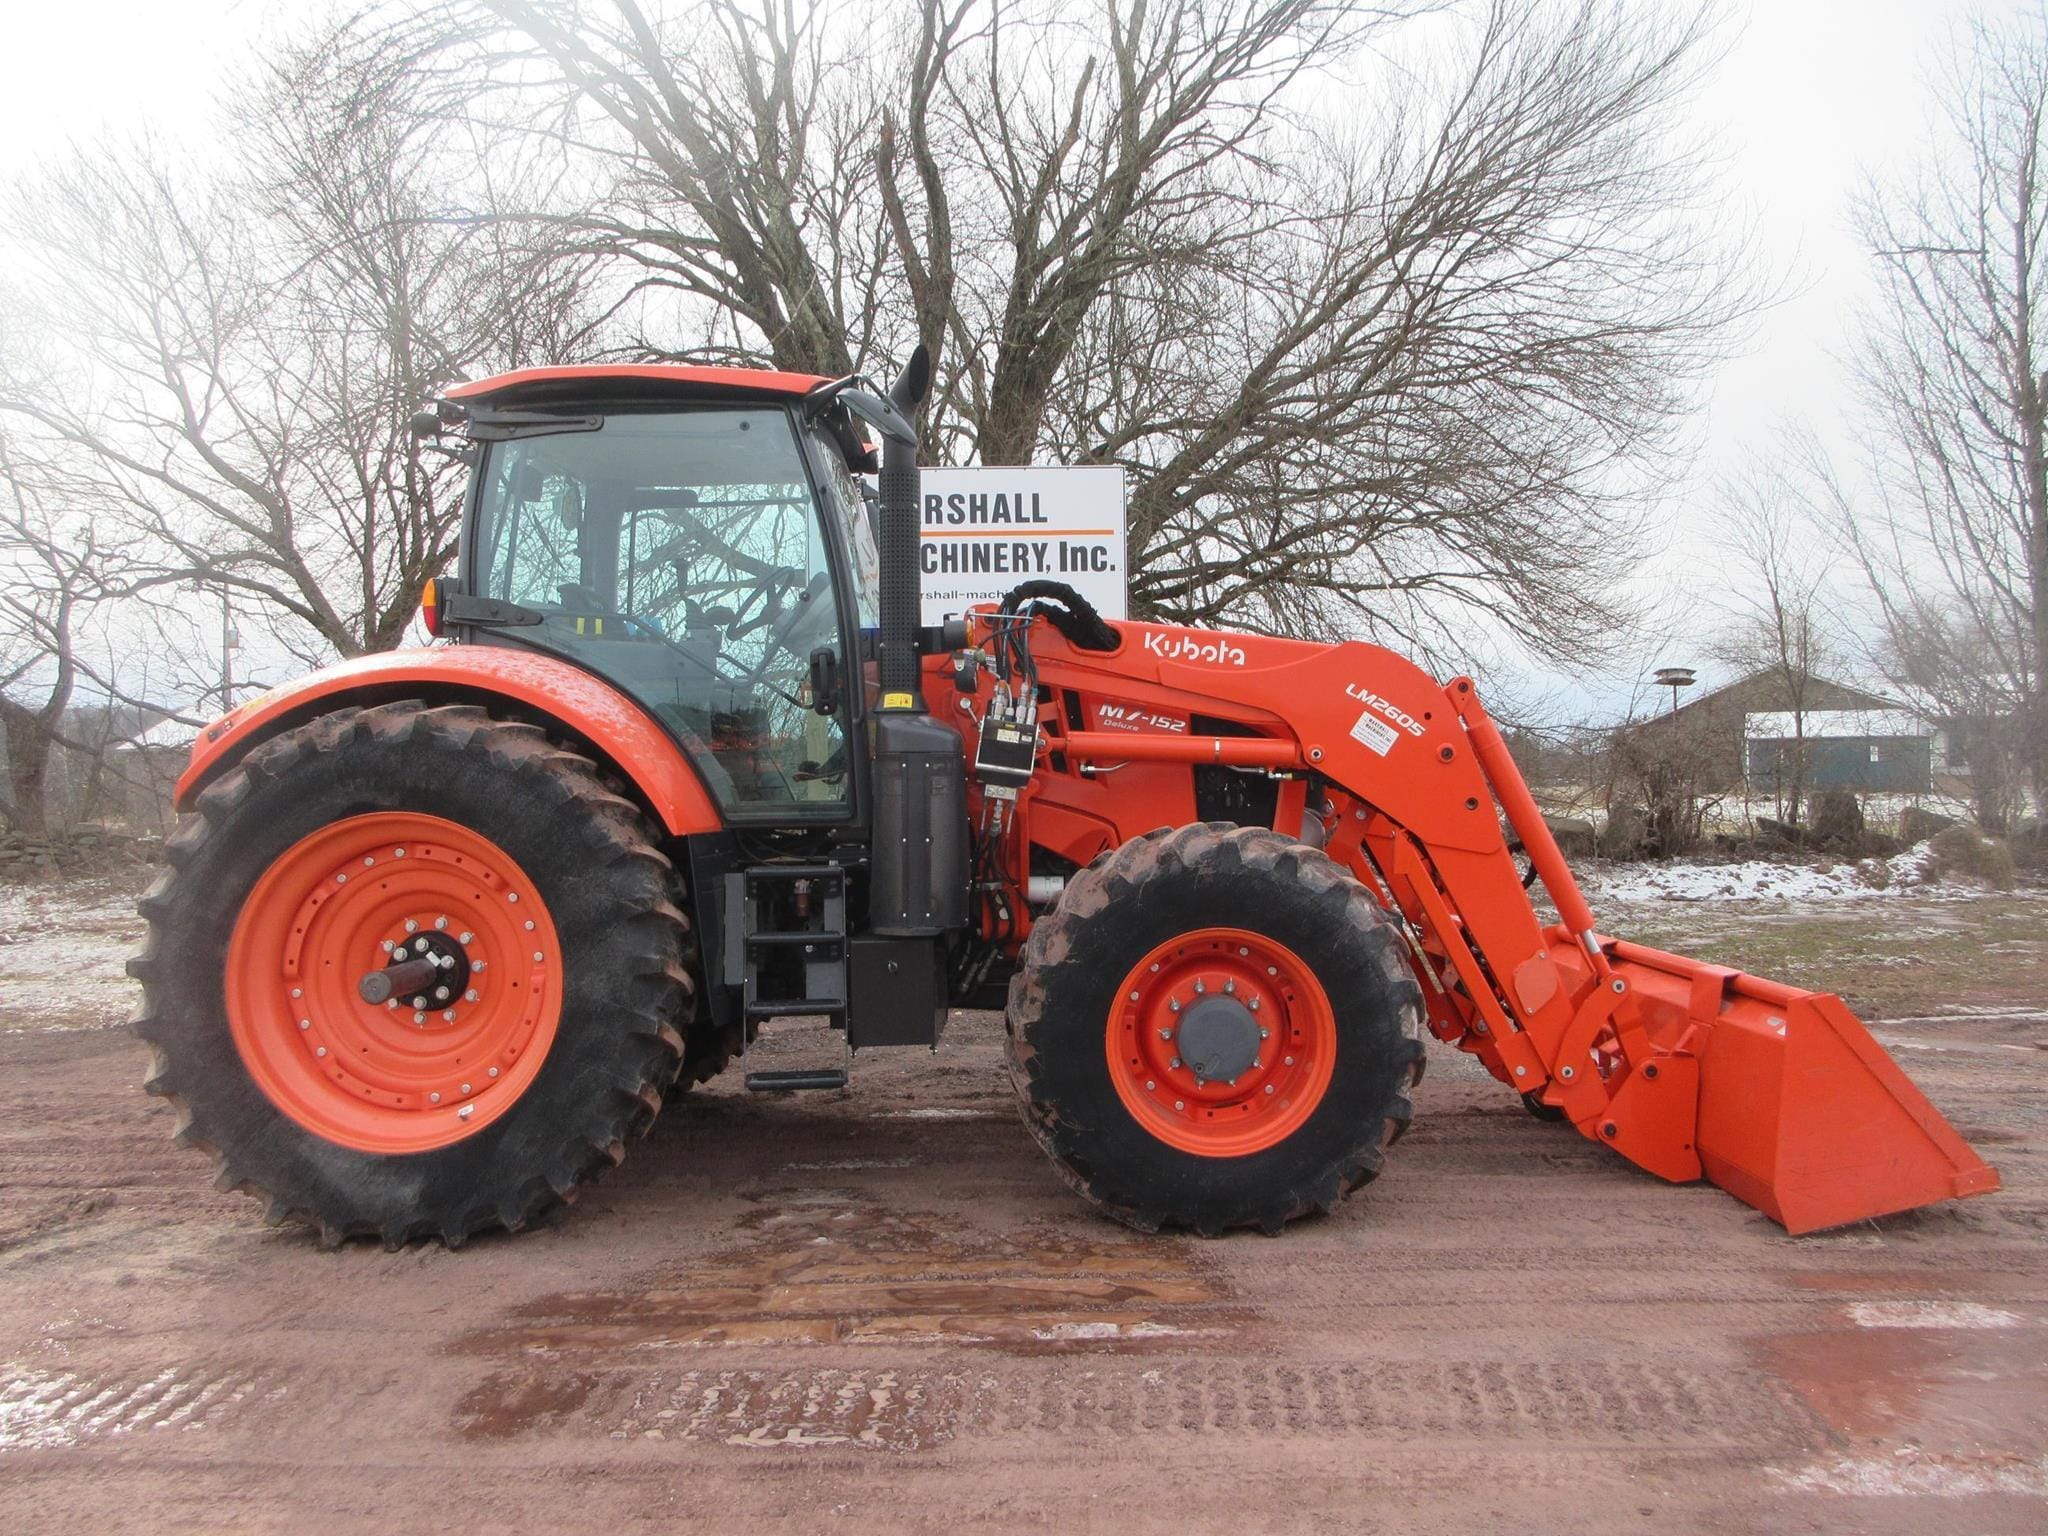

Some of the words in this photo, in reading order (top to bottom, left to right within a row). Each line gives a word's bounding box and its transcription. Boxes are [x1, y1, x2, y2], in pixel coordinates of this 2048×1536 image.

[924, 493, 1048, 524] RSHALL
[920, 542, 1051, 574] CHINERY,
[1059, 541, 1115, 572] Inc.
[1144, 631, 1245, 665] Kubota
[1103, 719, 1140, 732] Deluxe
[1345, 683, 1426, 737] LM2605
